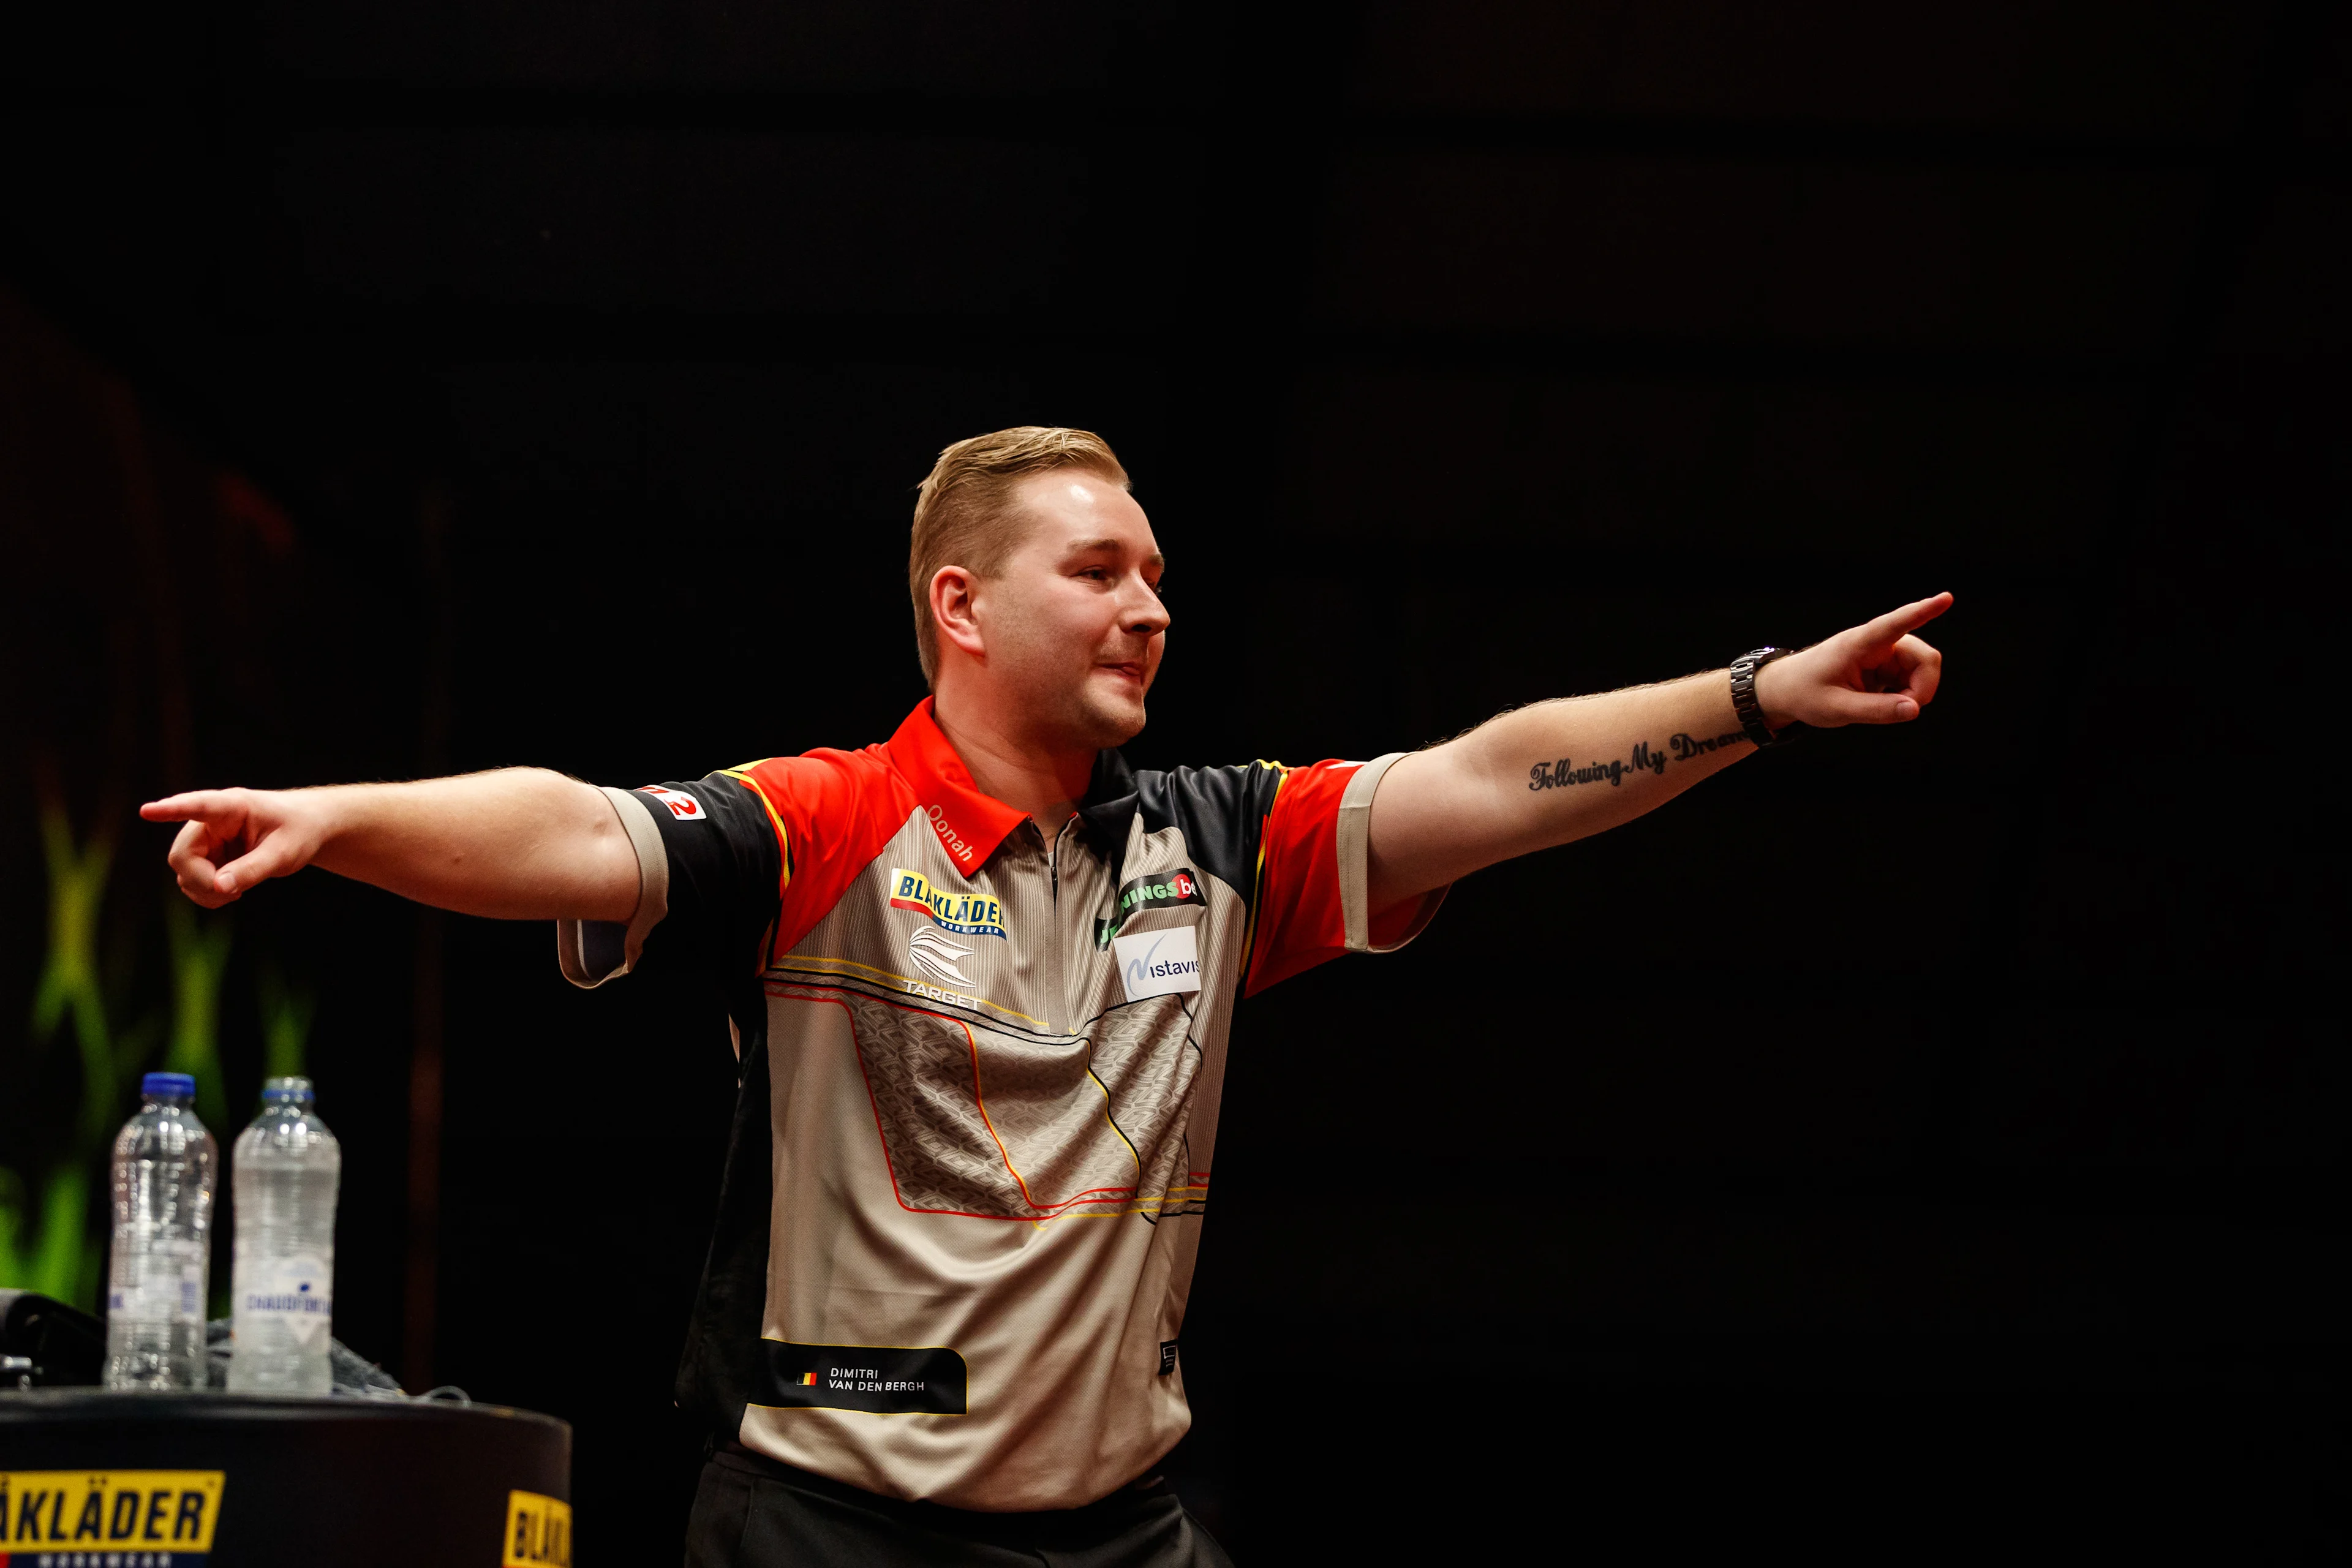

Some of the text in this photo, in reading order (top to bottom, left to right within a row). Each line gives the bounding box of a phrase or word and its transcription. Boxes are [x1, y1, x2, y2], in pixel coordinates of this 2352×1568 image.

[1529, 758, 1621, 791] Following
[1623, 741, 1667, 775] My
[927, 804, 973, 862] Oonah
[941, 920, 1000, 935] WORKWEAR
[903, 979, 982, 1011] TARGET
[830, 1367, 878, 1379] DIMITRI
[829, 1379, 924, 1392] VAN DEN BERGH
